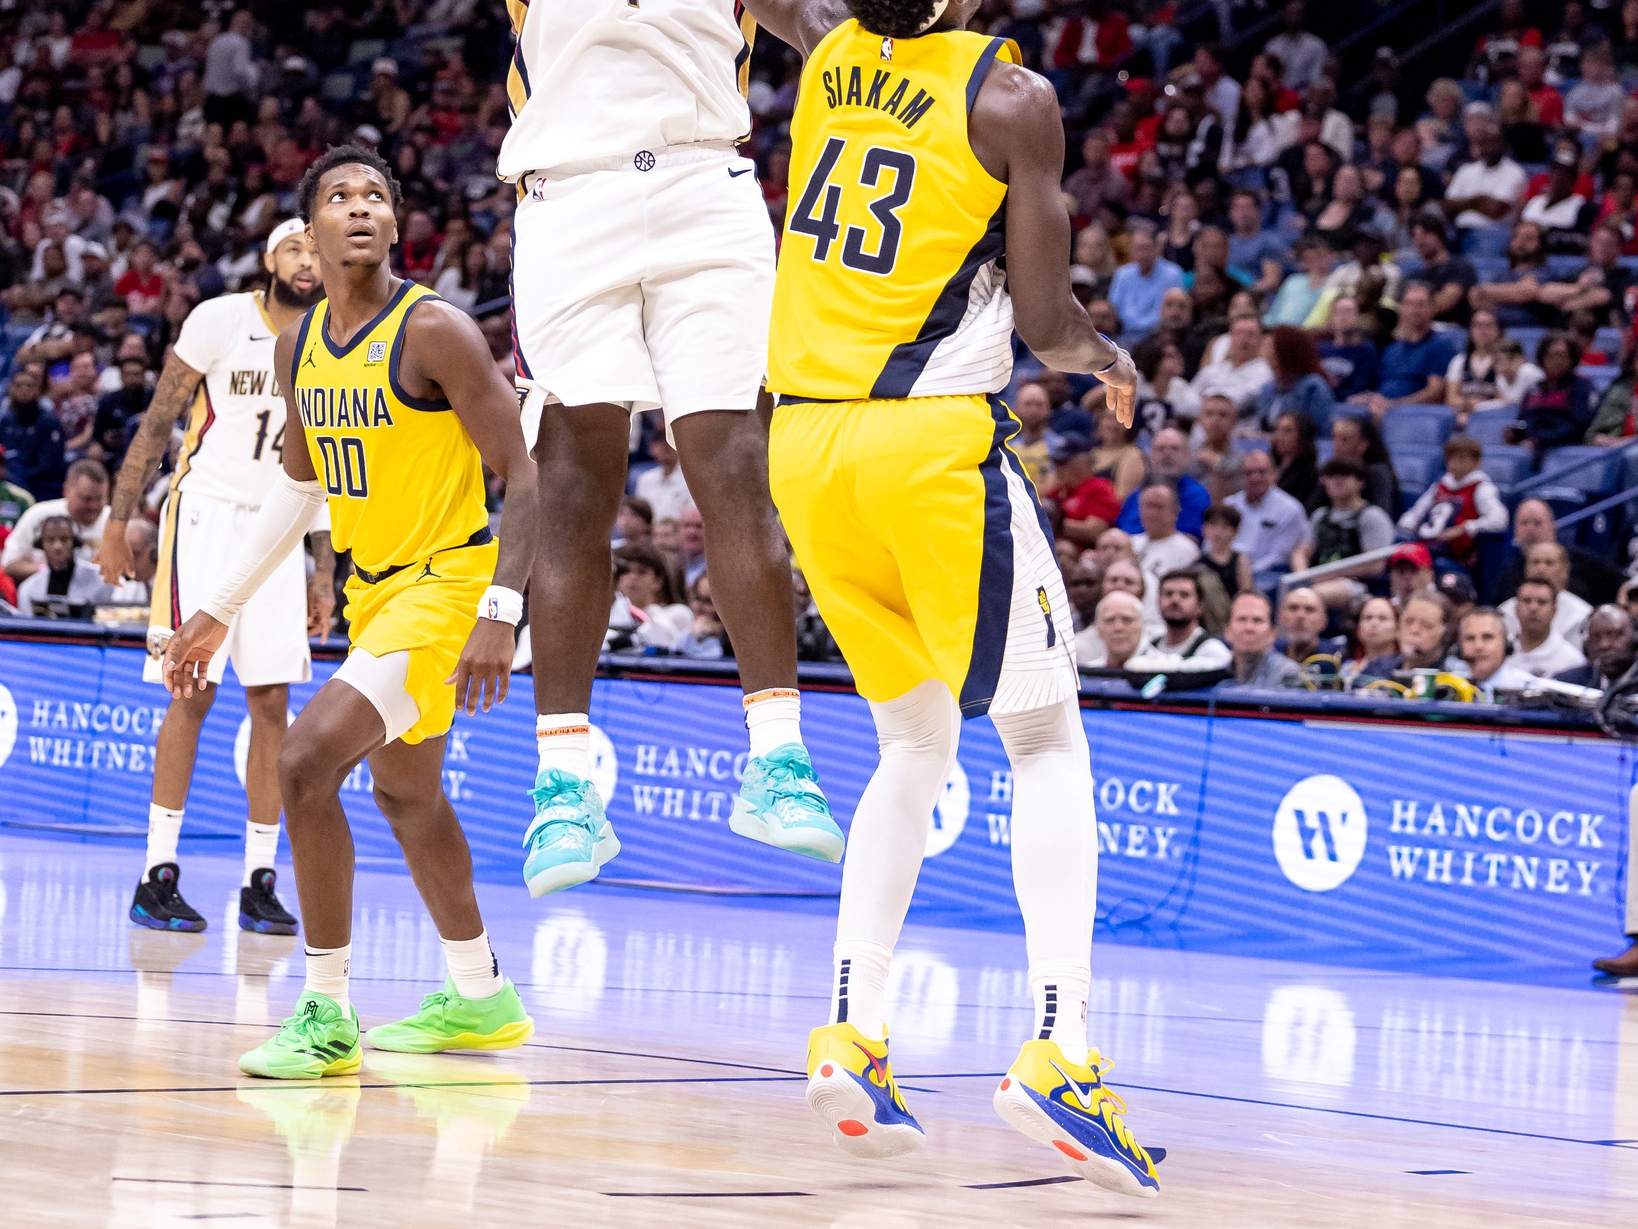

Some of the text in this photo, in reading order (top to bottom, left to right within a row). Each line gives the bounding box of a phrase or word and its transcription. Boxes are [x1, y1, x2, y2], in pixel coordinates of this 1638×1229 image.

[822, 65, 936, 129] SIAKAM
[787, 135, 916, 277] 43
[229, 370, 268, 396] NEW
[295, 386, 394, 428] INDIANA
[315, 435, 369, 499] 00
[632, 784, 736, 823] WHIT
[988, 770, 1181, 815] HOCK
[986, 812, 1177, 860] WNEY
[1389, 799, 1604, 849] HANCOCK
[1387, 845, 1601, 896] WHITNEY
